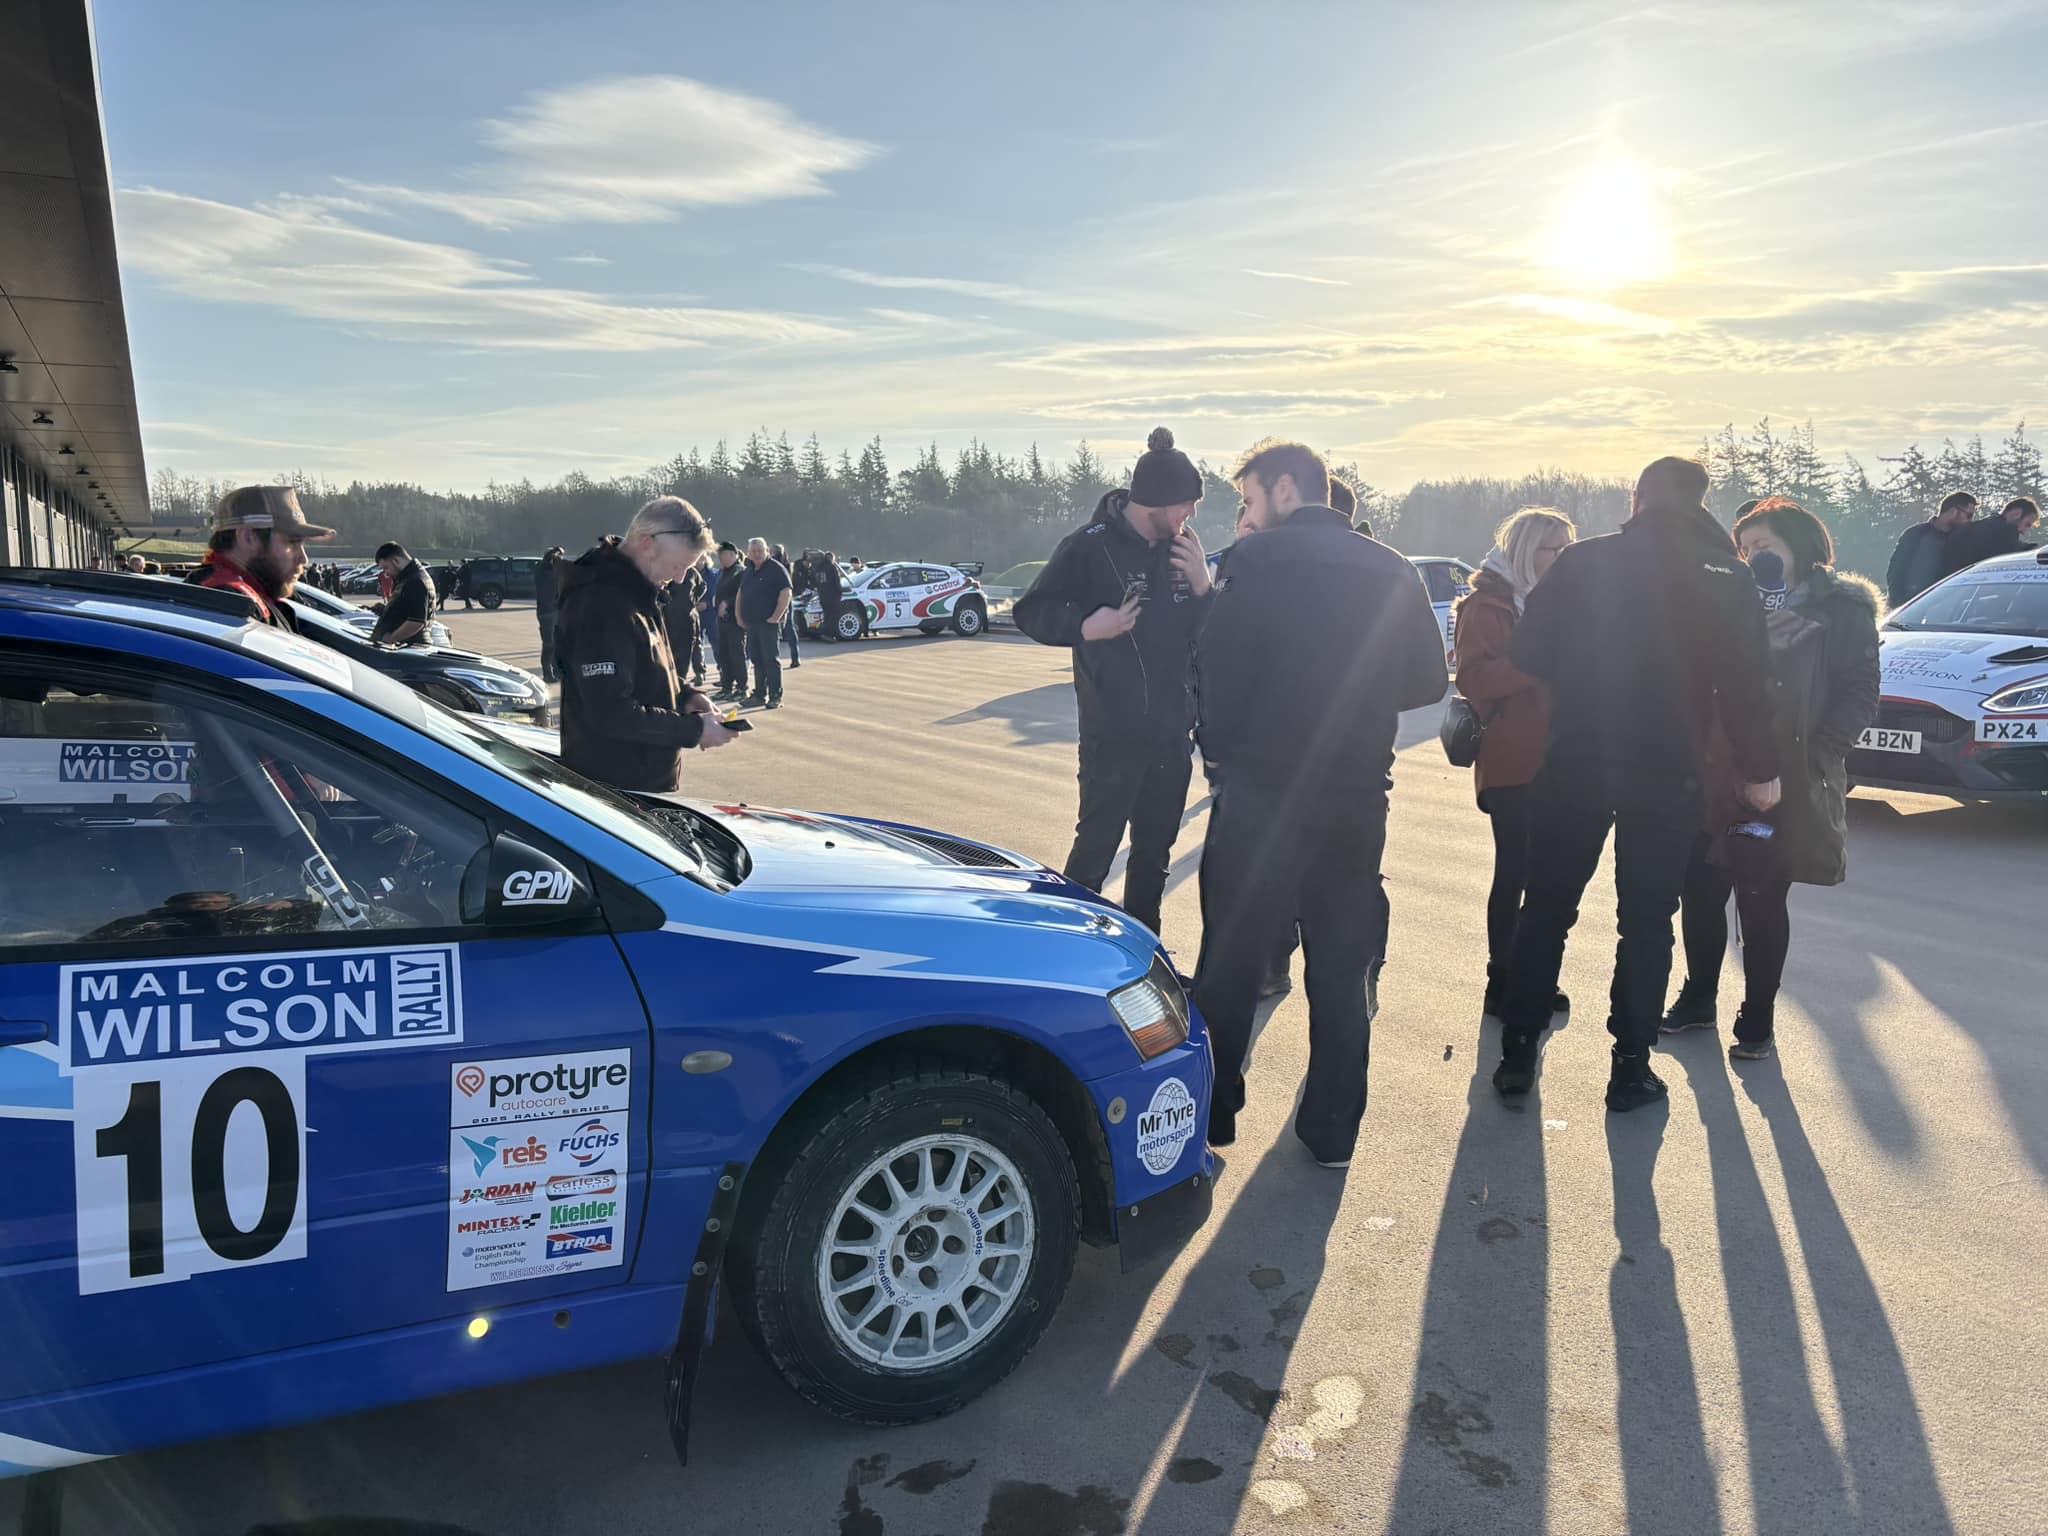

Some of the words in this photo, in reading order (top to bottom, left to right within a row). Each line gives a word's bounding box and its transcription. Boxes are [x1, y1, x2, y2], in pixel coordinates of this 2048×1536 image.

[895, 603, 901, 617] 5
[1877, 731, 1913, 750] BZN
[1983, 722, 2038, 739] PX24
[502, 870, 573, 904] GPM
[80, 959, 376, 1002] MALCOLM
[397, 959, 443, 1033] RALLY
[77, 990, 377, 1059] WILSON
[489, 1063, 627, 1108] protyre
[472, 1115, 507, 1124] 2025
[514, 1110, 555, 1120] RALLY
[562, 1105, 610, 1115] SERIES
[501, 1096, 567, 1111] autocare
[1140, 1114, 1162, 1136] Mr
[1164, 1103, 1193, 1128] Tyre
[502, 1136, 548, 1165] reis
[559, 1132, 620, 1152] FUCHS
[1139, 1123, 1192, 1154] motorsport
[95, 1066, 300, 1279] 10
[457, 1215, 521, 1233] MINTEX
[550, 1200, 617, 1225] Kielder
[477, 1225, 521, 1236] RACING
[552, 1234, 607, 1252] BTRDA
[966, 1207, 984, 1255] speedline
[474, 1256, 527, 1269] Championship
[475, 1252, 502, 1262] English
[503, 1249, 521, 1257] Rally
[877, 1249, 896, 1298] speedline
